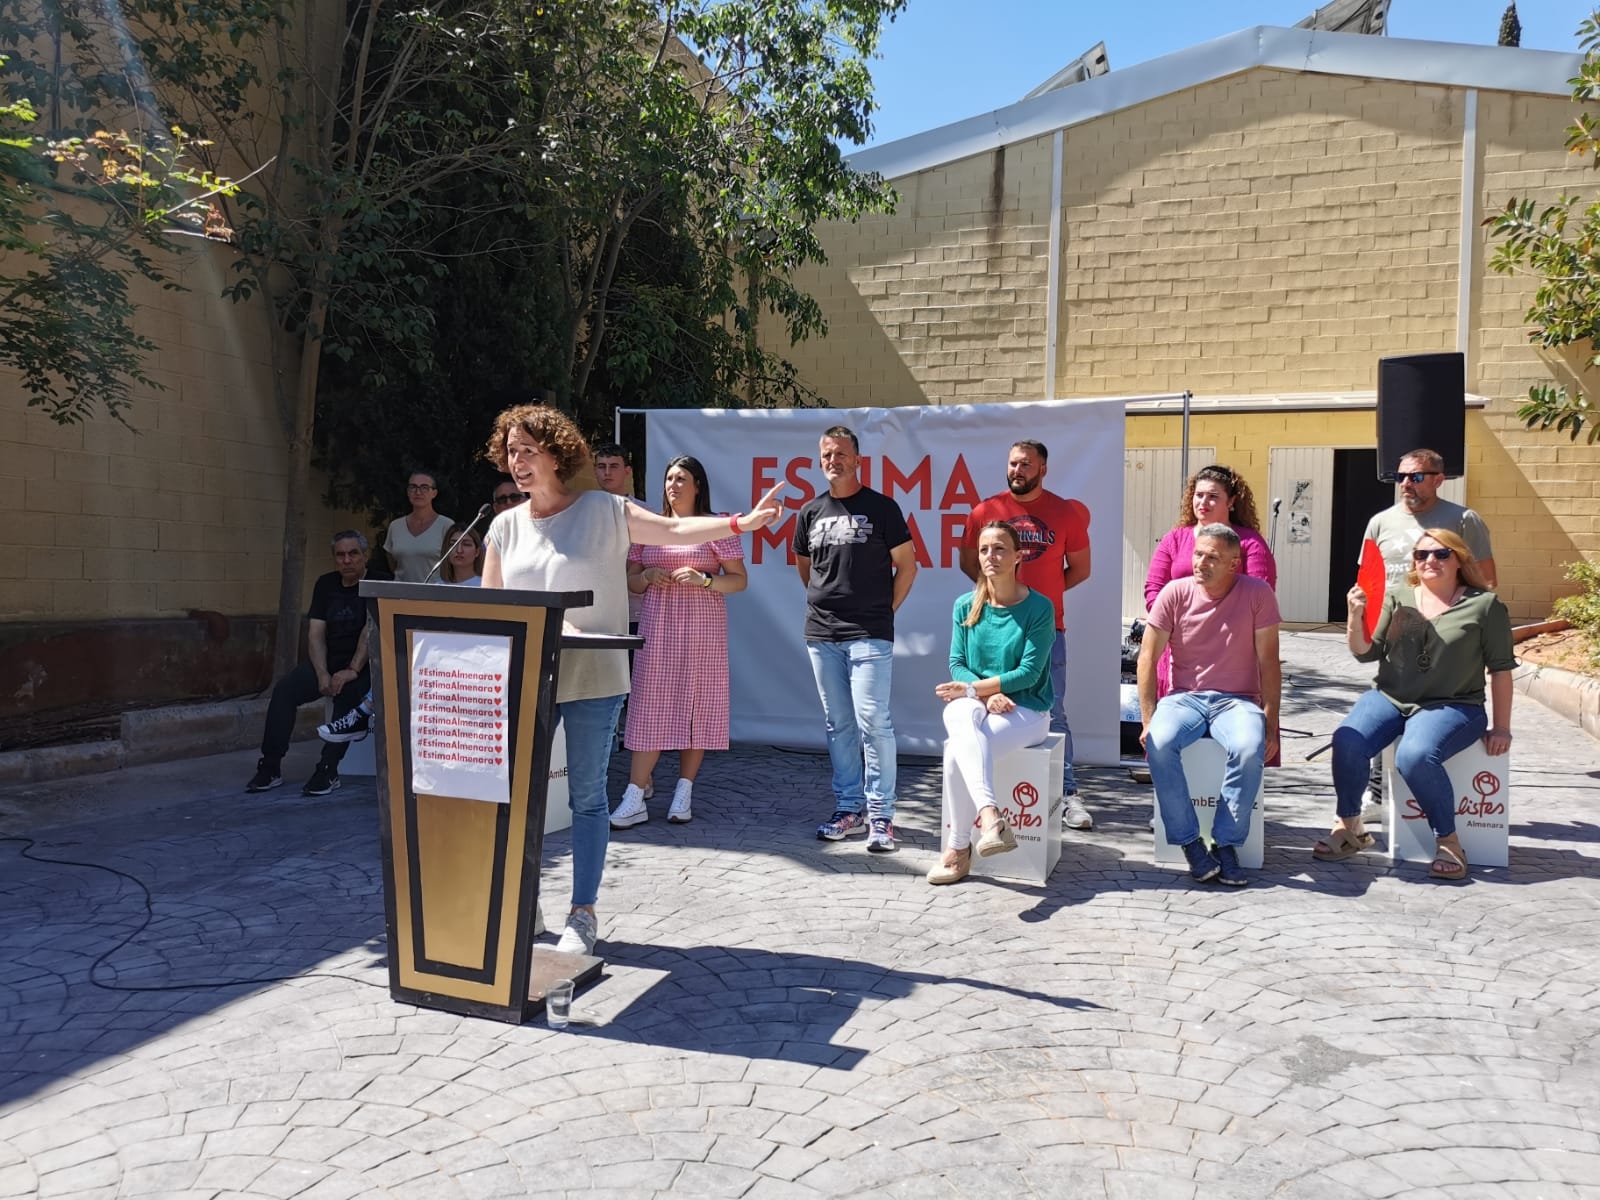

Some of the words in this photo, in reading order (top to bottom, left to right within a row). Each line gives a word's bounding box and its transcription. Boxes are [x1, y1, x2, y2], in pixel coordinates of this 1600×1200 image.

[751, 453, 982, 511] ESIMA
[810, 515, 874, 536] STAR
[1017, 529, 1056, 545] INALS
[418, 668, 493, 681] #EstimaAlmenara
[418, 680, 493, 693] #EstimaAlmenara
[418, 692, 492, 705] #EstimaAlmenara
[418, 704, 493, 717] #EstimaAlmenara
[418, 715, 494, 728] #EstimaAlmenara
[418, 727, 494, 740] #EstimaAlmenara
[418, 738, 494, 752] #EstimaAlmenara
[418, 750, 494, 764] #EstimaAlmenara
[1466, 820, 1504, 829] Almenara
[1014, 833, 1041, 842] menara
